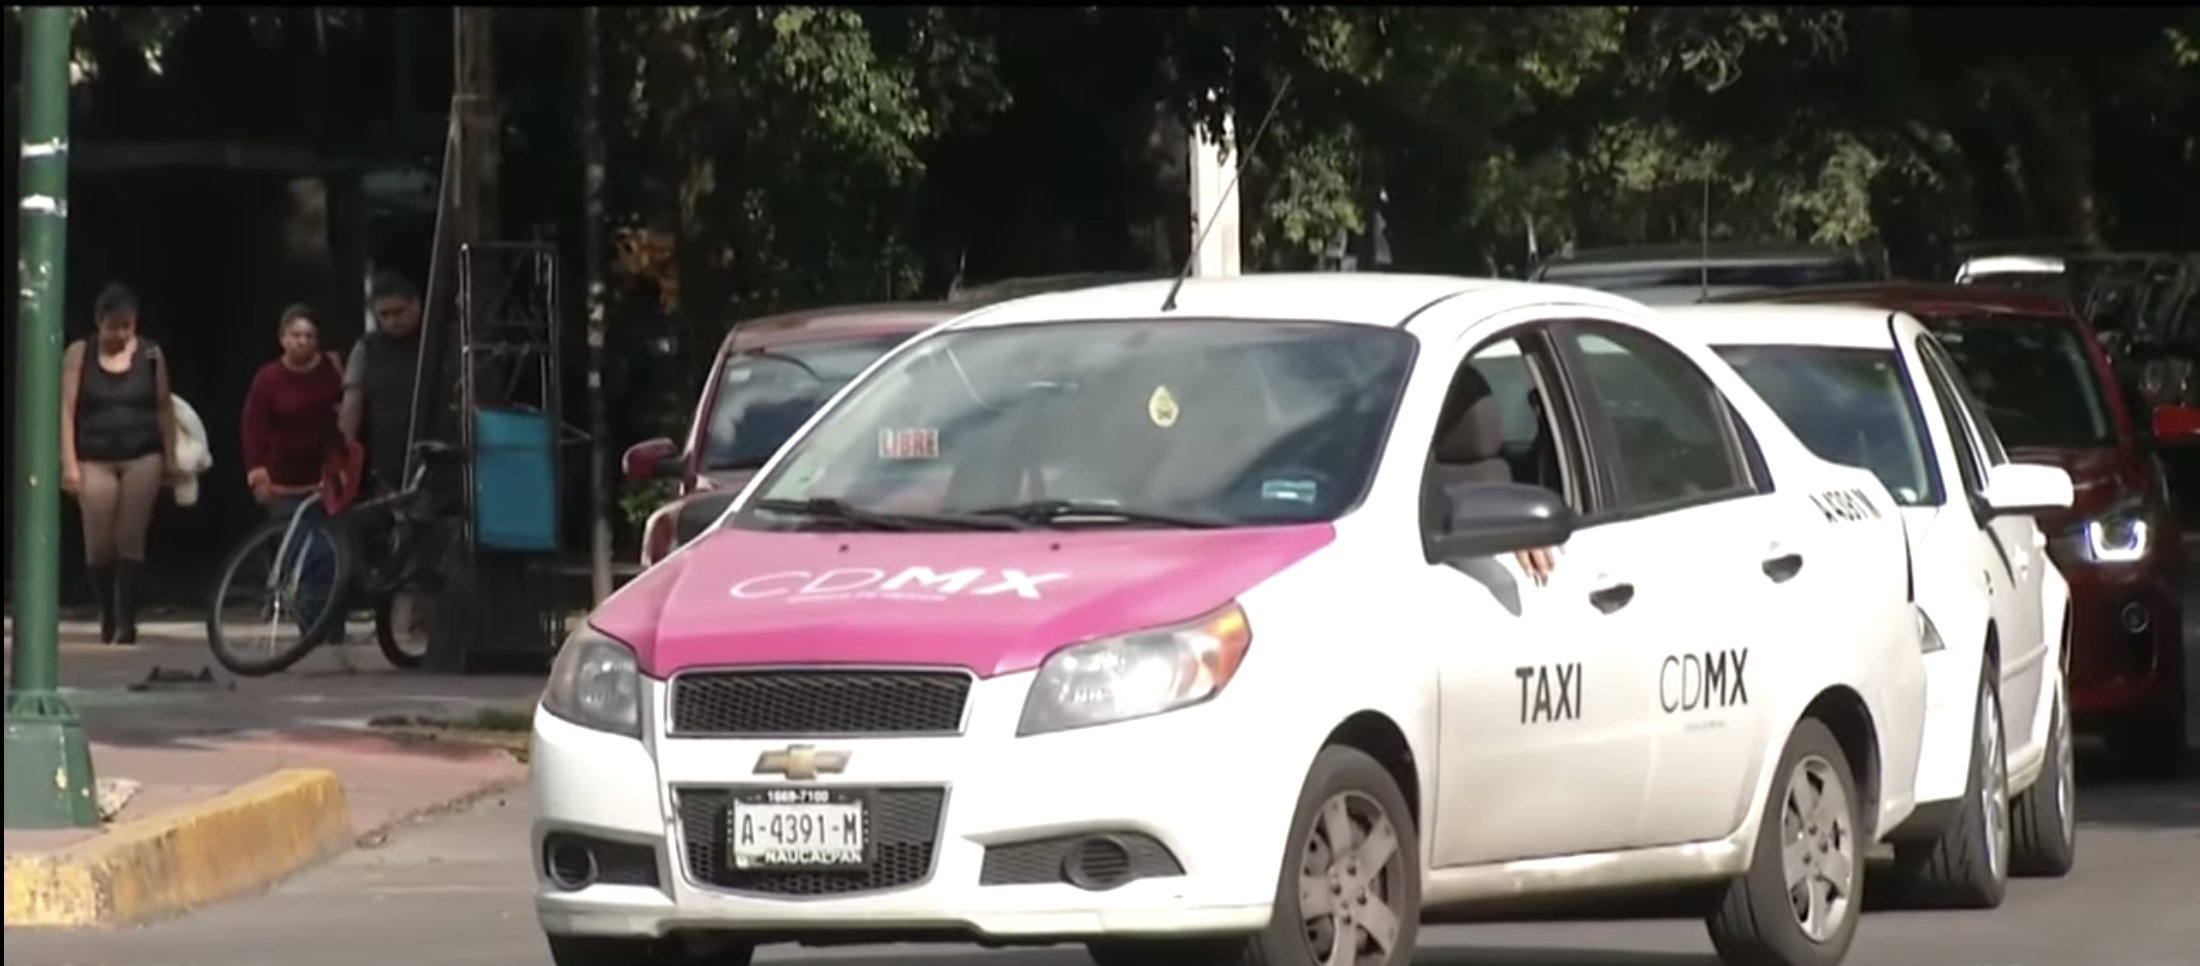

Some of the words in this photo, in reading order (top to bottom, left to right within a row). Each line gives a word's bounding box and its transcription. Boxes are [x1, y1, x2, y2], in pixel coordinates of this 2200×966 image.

[880, 430, 938, 456] LIBRE
[730, 566, 1069, 598] CDMX
[1515, 663, 1582, 724] TAXI
[1659, 648, 1748, 713] CDMX
[741, 814, 857, 845] A-4391-M
[765, 849, 862, 864] NAUCALPAN
